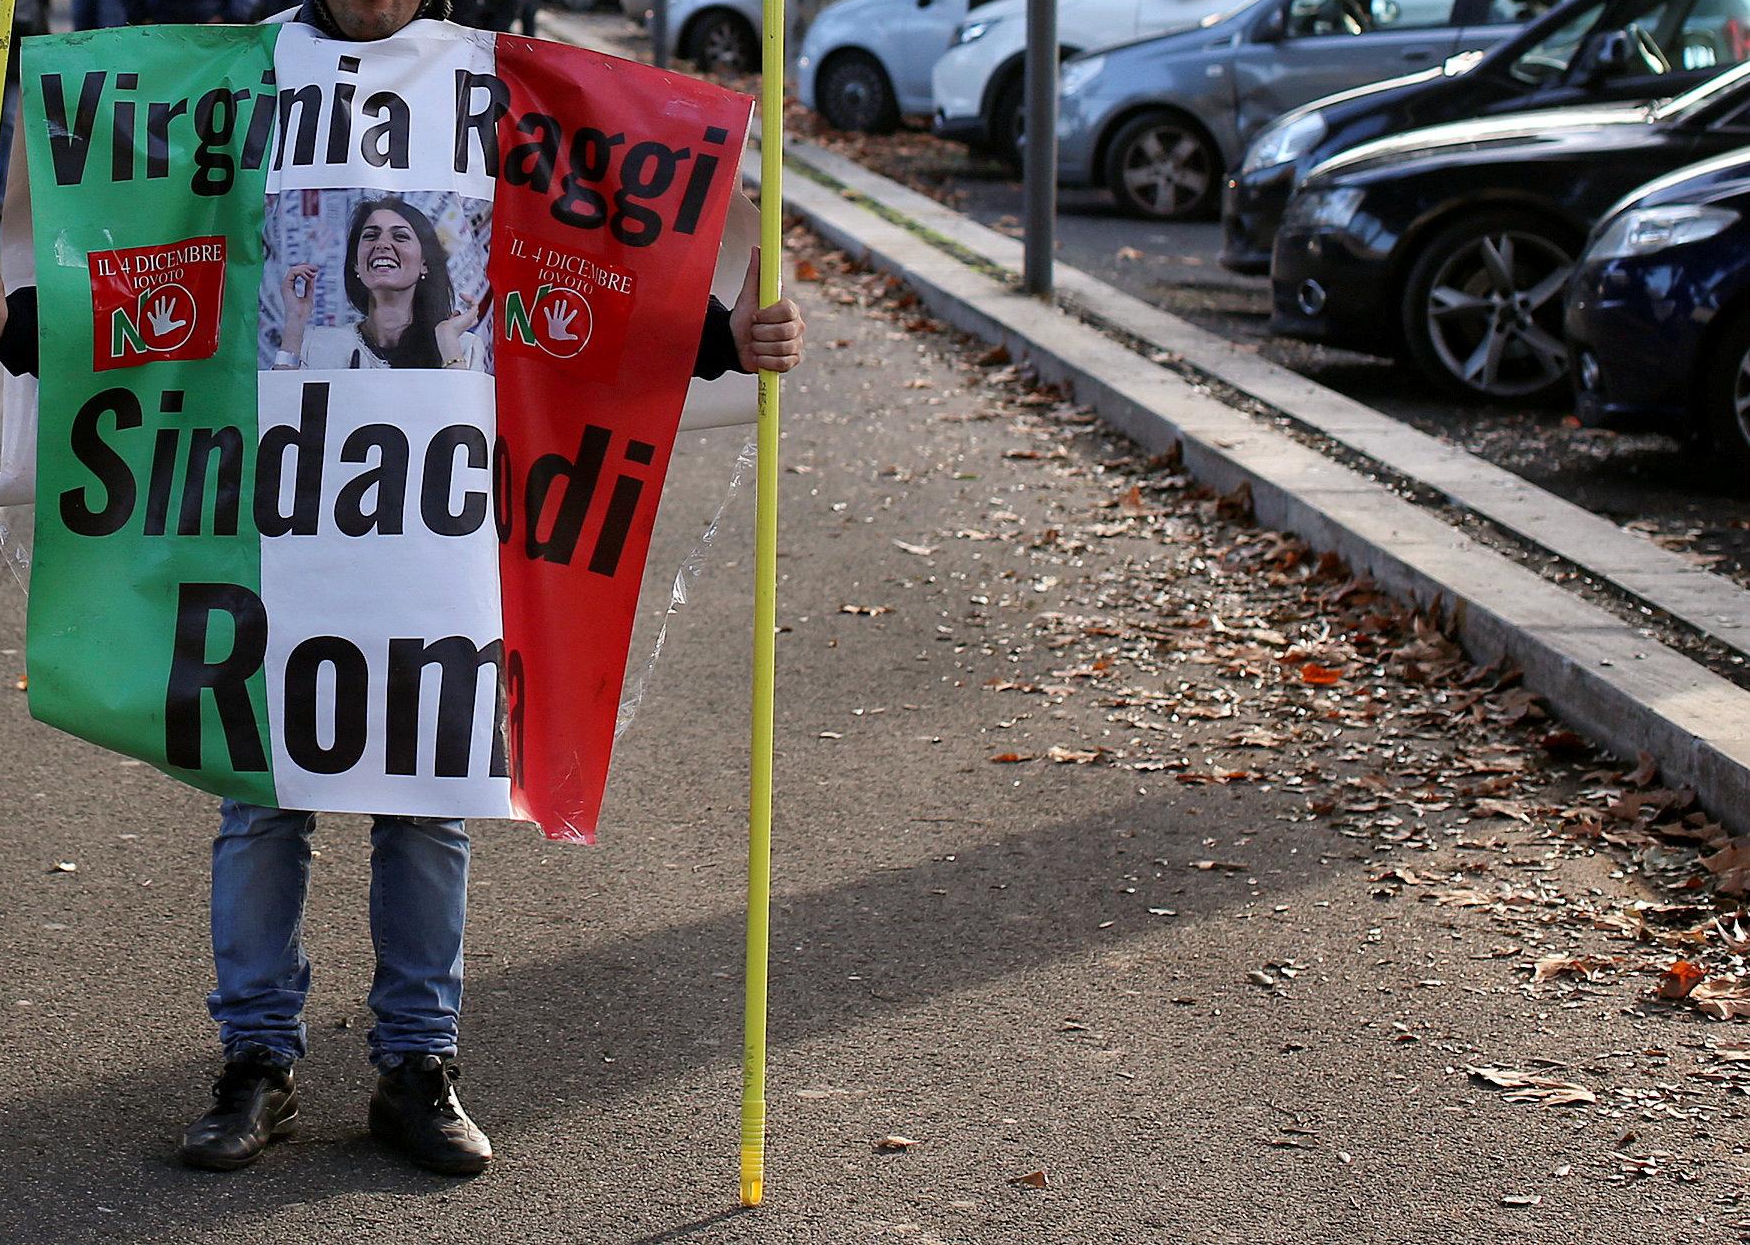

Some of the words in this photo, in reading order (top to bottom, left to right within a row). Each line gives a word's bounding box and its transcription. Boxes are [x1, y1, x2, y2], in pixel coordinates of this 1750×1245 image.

[40, 55, 412, 197] Virginia
[454, 69, 729, 247] Raggi
[97, 259, 117, 276] IL
[121, 257, 131, 274] 4
[135, 244, 222, 273] DICEMBRE
[510, 239, 526, 259] IL
[545, 250, 633, 295] DICEMBRE
[59, 382, 513, 545] Sindaco
[524, 423, 656, 578] di
